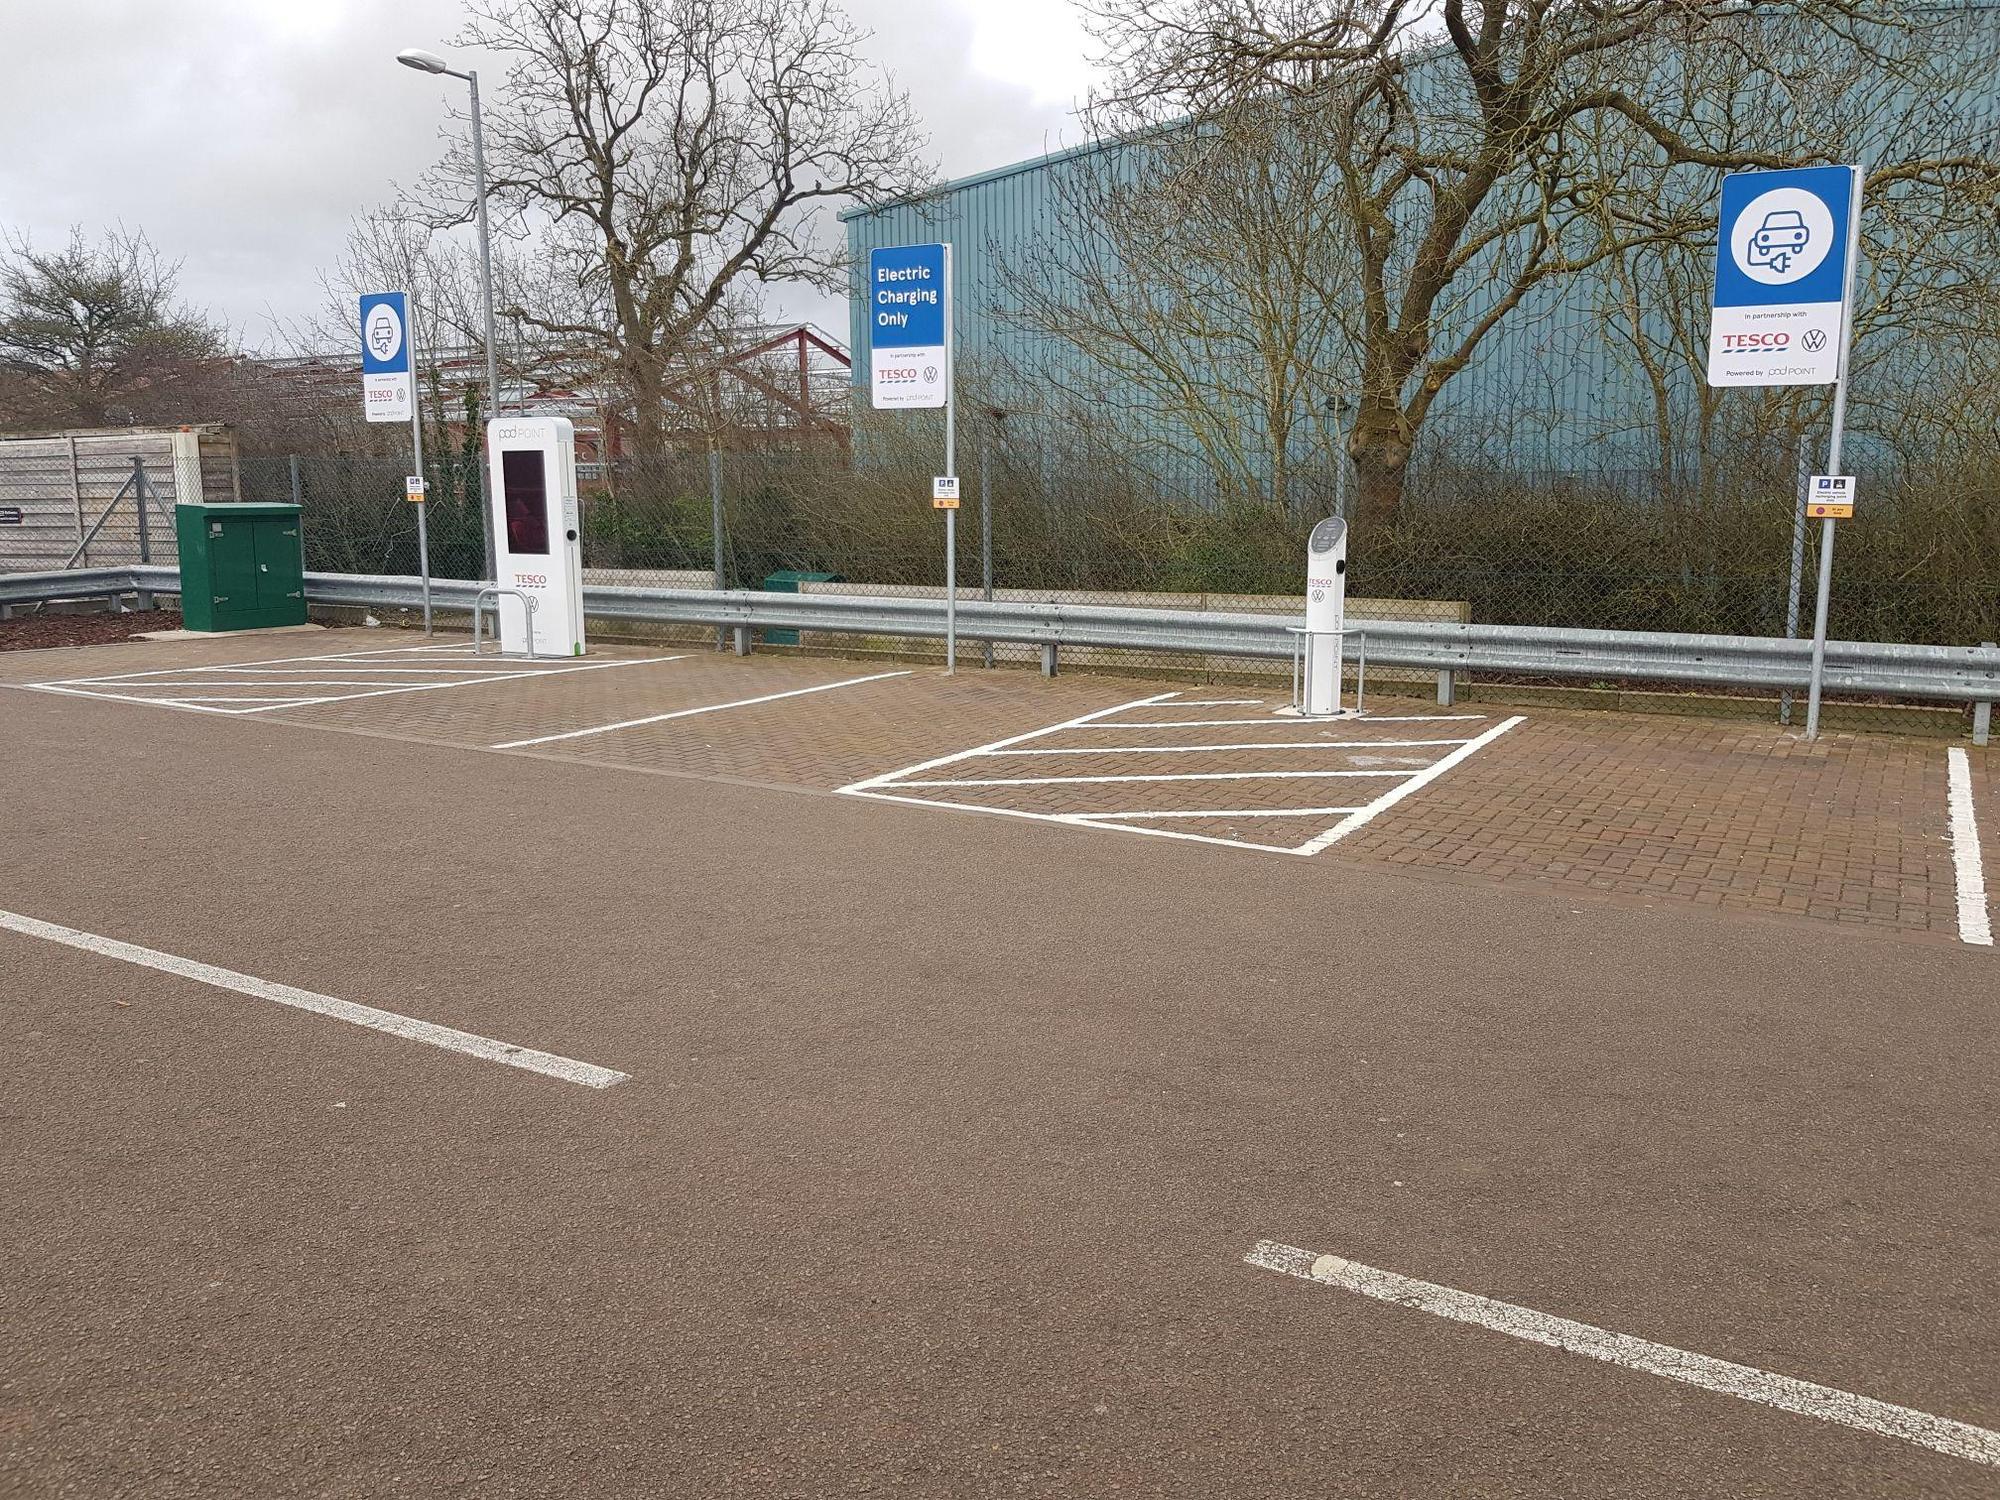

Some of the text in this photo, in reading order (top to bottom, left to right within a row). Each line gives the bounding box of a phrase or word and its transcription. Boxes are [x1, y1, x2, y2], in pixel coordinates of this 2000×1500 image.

[878, 265, 930, 282] Electric
[878, 288, 937, 306] Charging
[878, 312, 908, 328] Only
[1752, 311, 1791, 320] partnership
[1722, 333, 1790, 347] TESCO
[879, 368, 917, 379] TESCO
[1726, 369, 1754, 377] Powered
[1755, 370, 1763, 378] by
[368, 390, 392, 398] TESCO
[515, 574, 547, 584] TESCO
